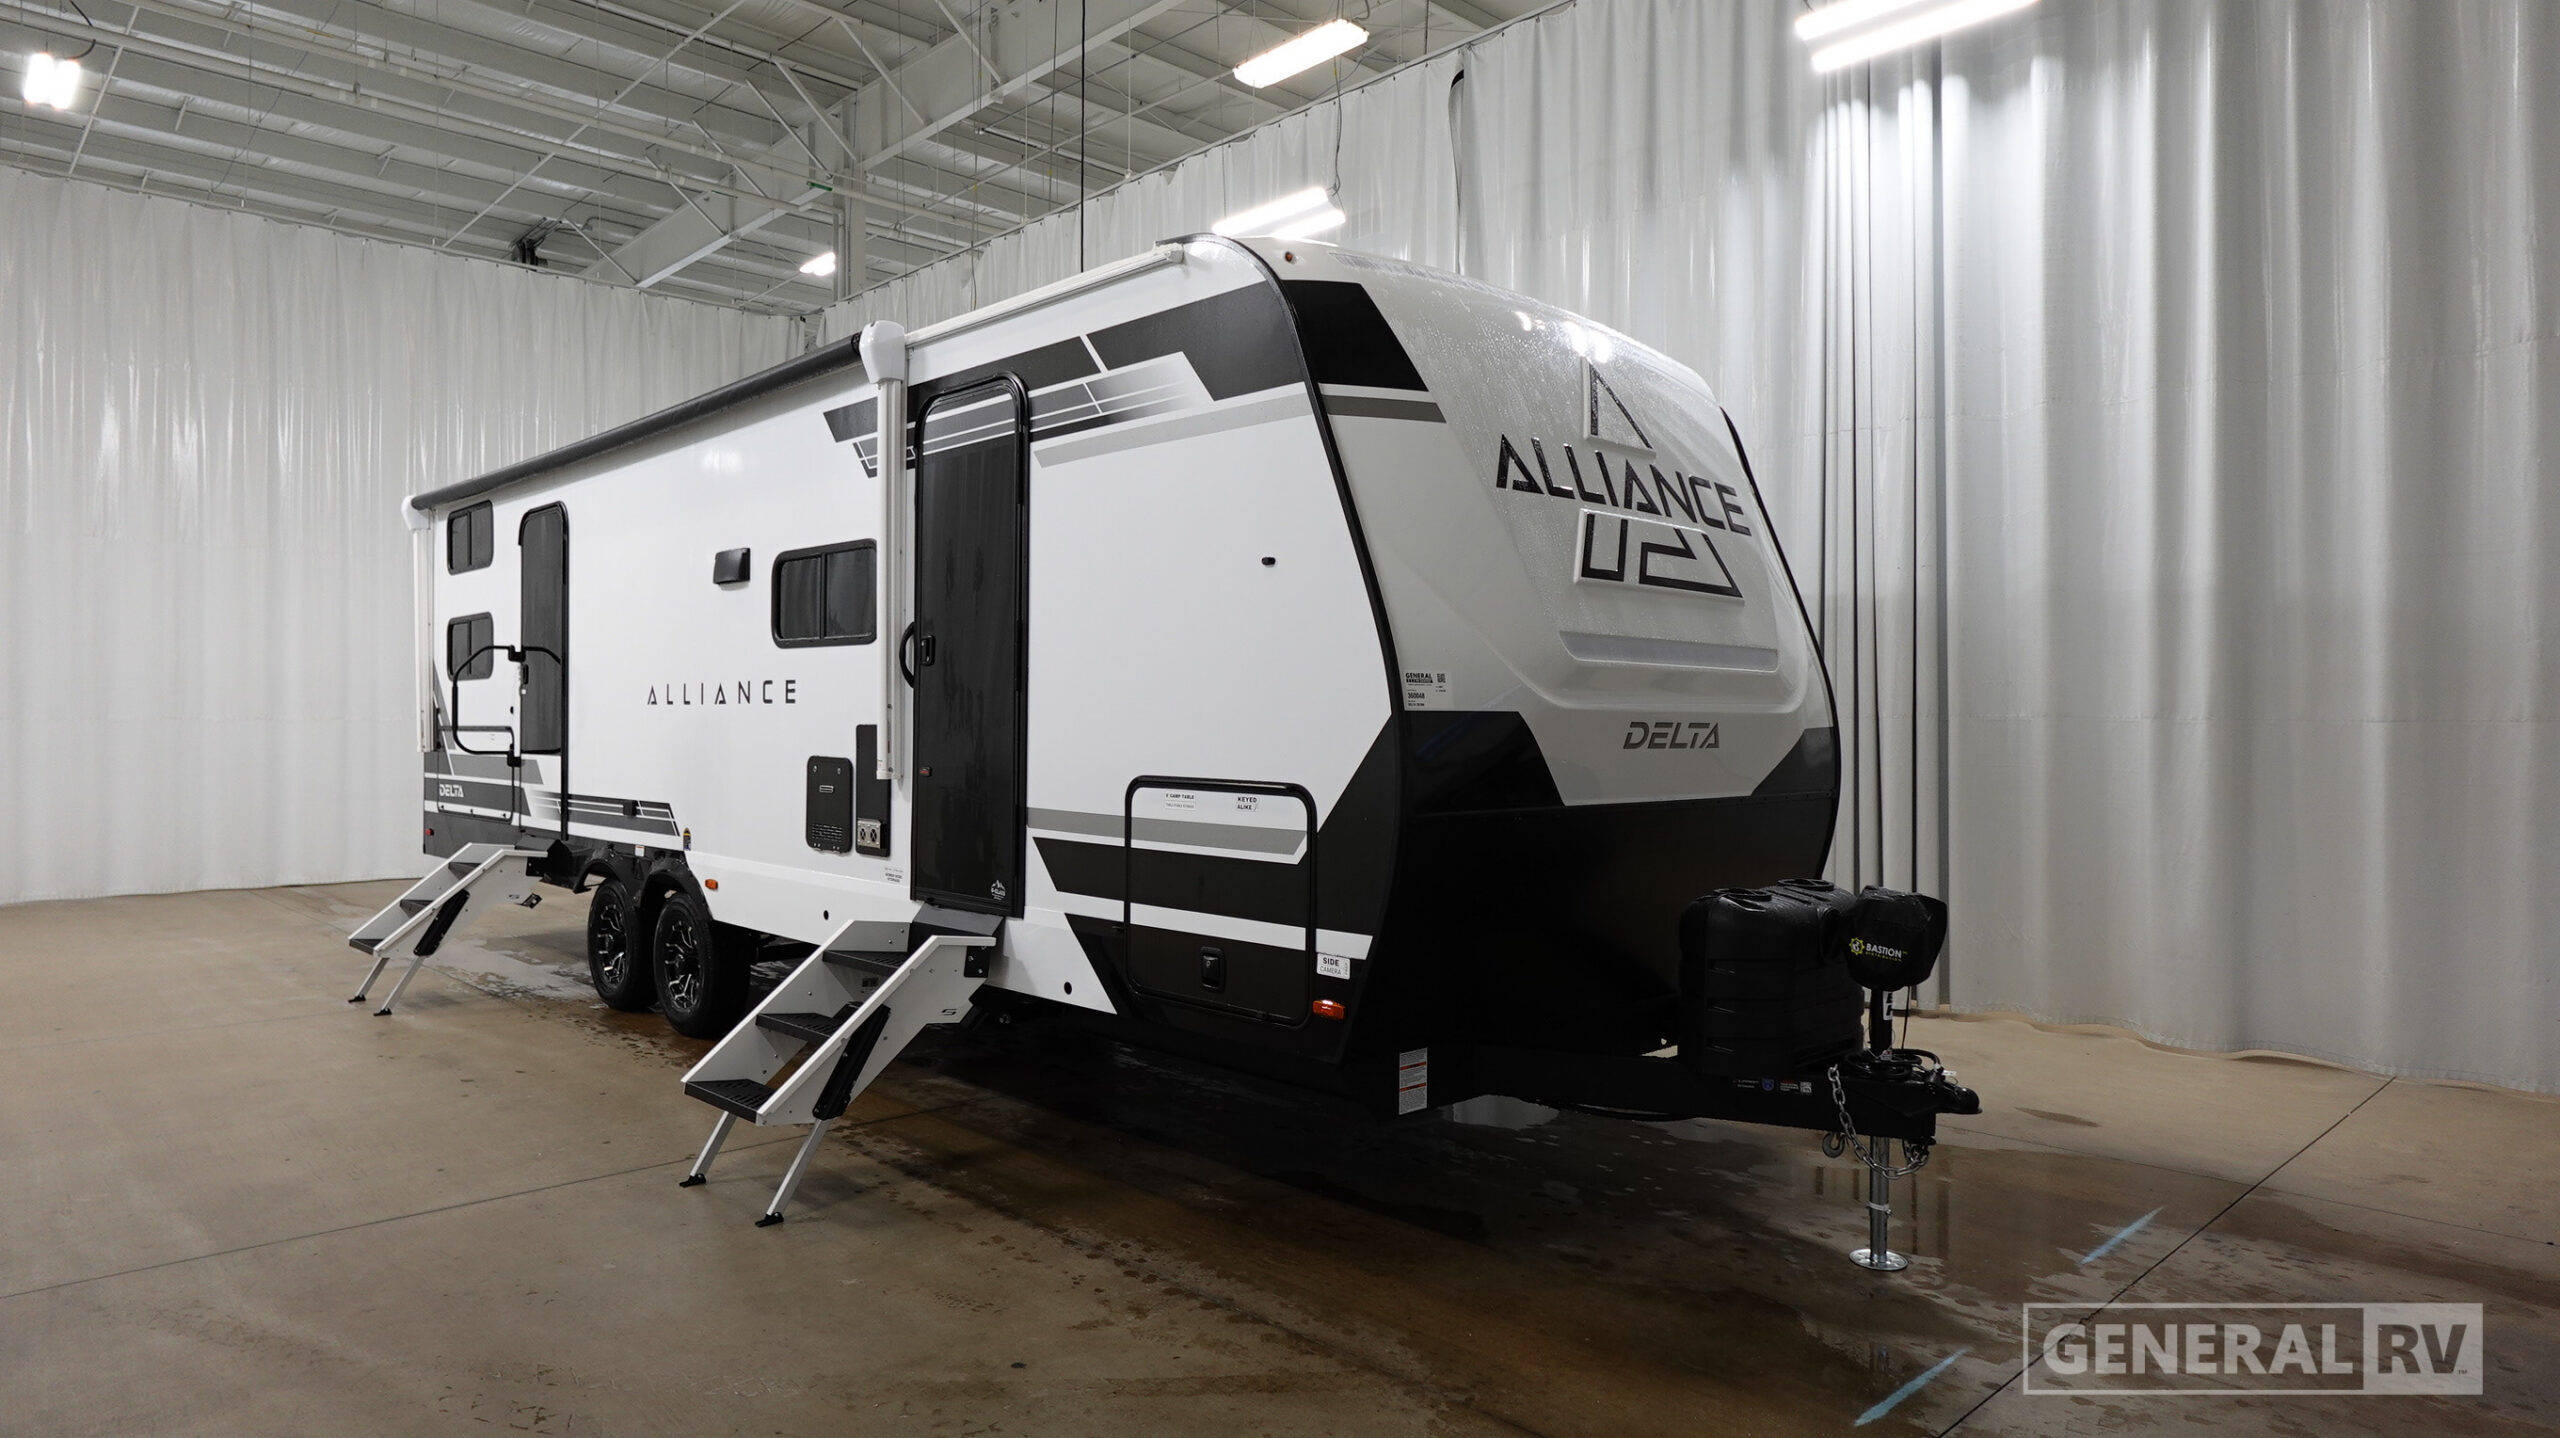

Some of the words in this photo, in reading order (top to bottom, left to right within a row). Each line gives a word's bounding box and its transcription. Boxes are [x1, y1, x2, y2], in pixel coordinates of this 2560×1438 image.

[1496, 434, 1752, 536] ALLIANCE
[647, 680, 796, 705] ALLIANCE
[1623, 722, 1720, 749] DELTA
[439, 783, 465, 798] DELTA
[1866, 943, 1902, 958] BASTION
[1322, 957, 1340, 966] SIDE
